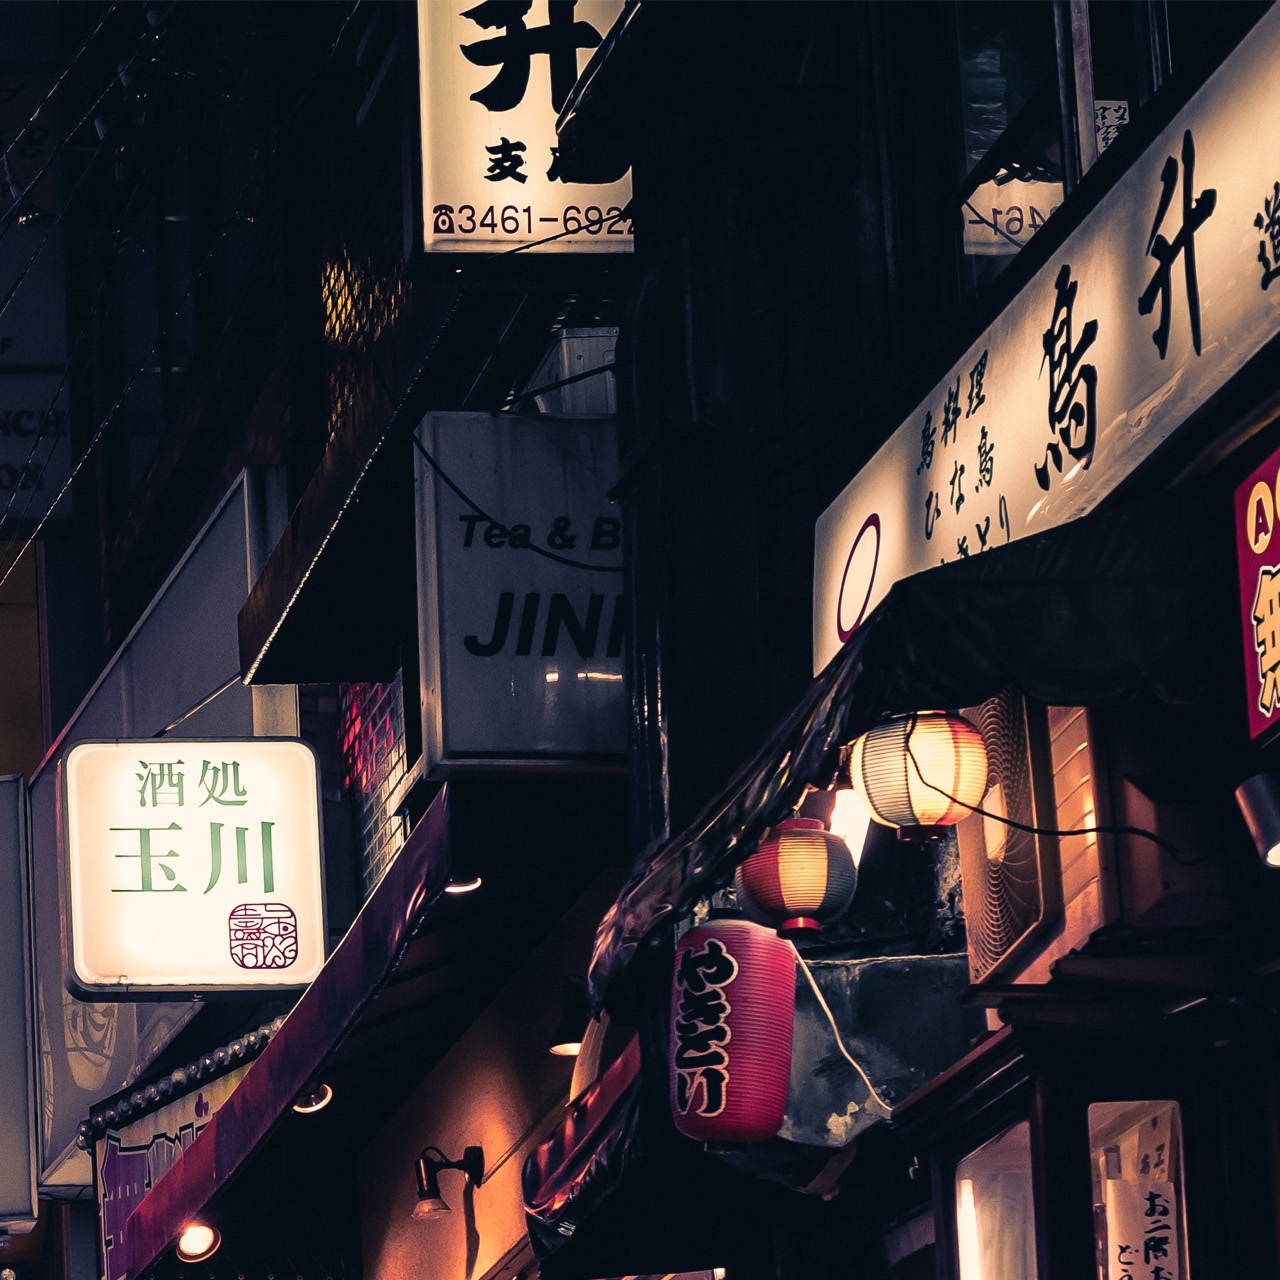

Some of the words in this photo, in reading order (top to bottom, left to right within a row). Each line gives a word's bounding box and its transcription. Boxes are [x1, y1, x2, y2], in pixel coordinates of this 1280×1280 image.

[485, 137, 564, 184] 支
[459, 513, 529, 549] Tea
[134, 759, 248, 809] 酒処
[109, 821, 278, 897] 玉川
